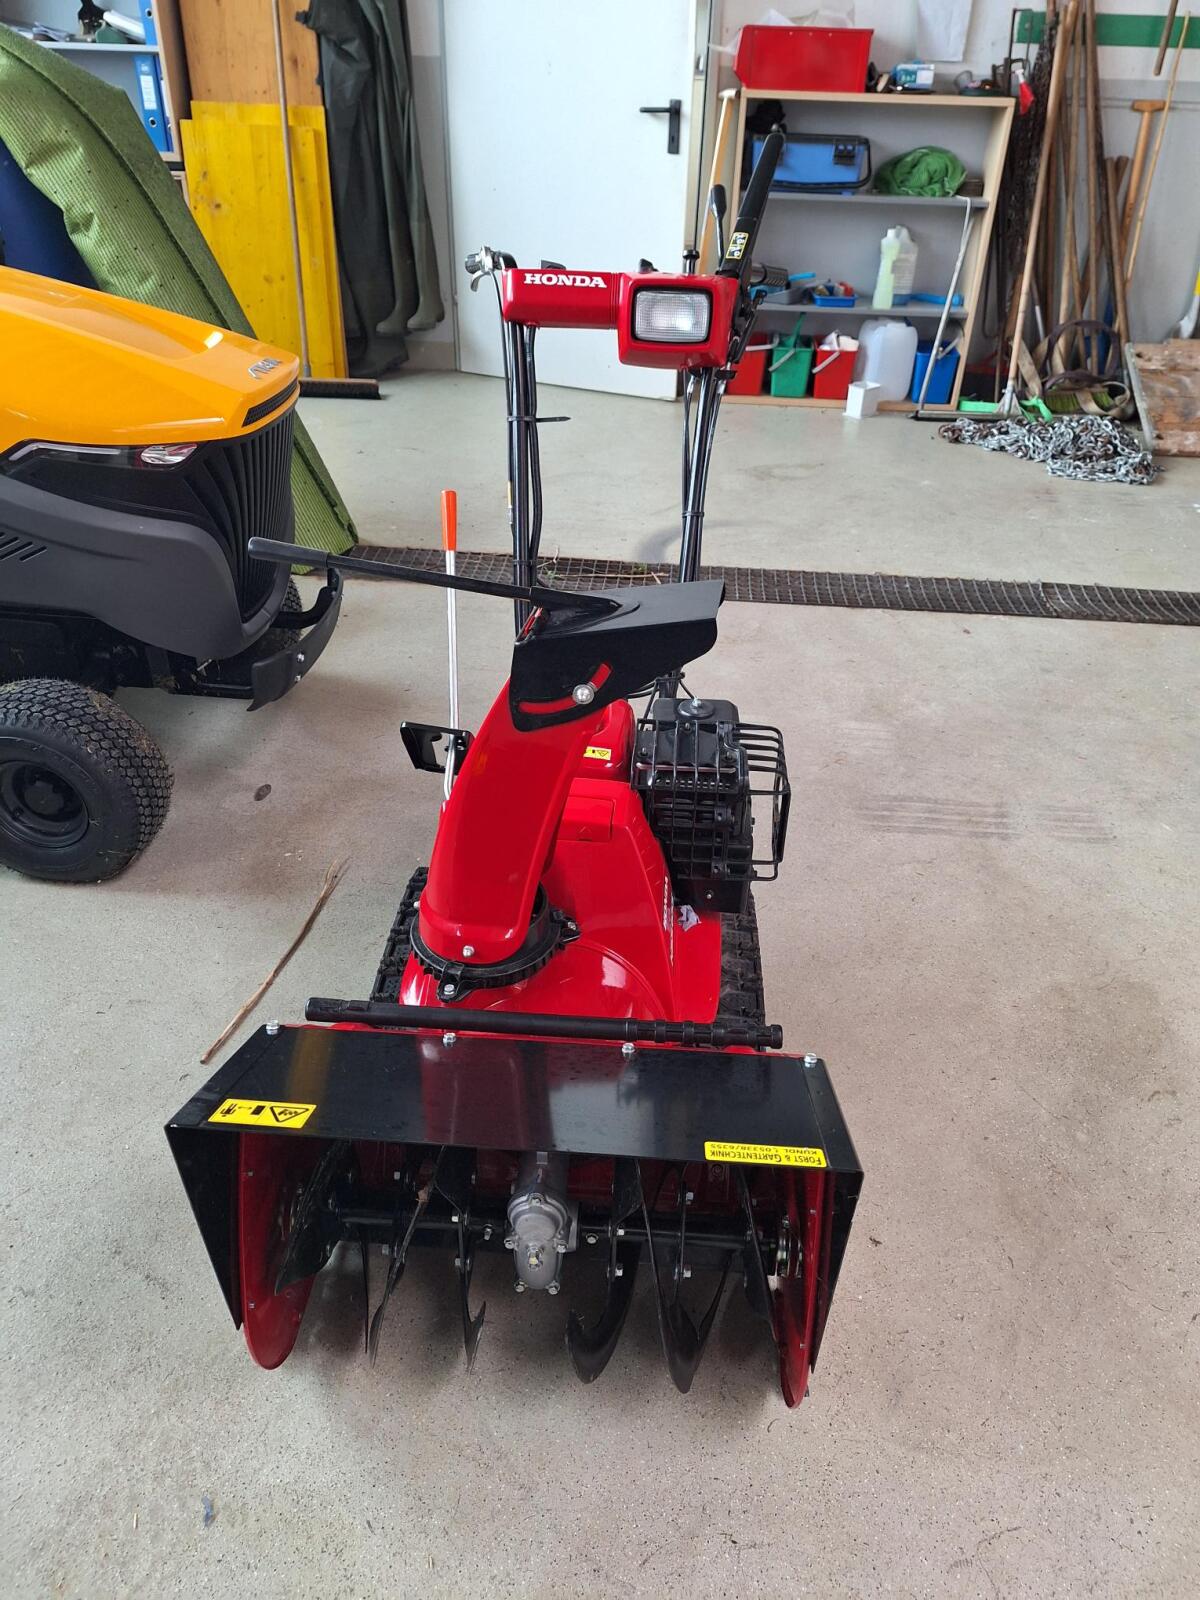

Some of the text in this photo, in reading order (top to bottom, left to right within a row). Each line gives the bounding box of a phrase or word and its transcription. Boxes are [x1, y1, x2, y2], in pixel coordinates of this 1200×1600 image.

[524, 273, 607, 288] HONDA
[710, 1150, 781, 1163] GARTENTECHNIK
[795, 1155, 822, 1166] FORST
